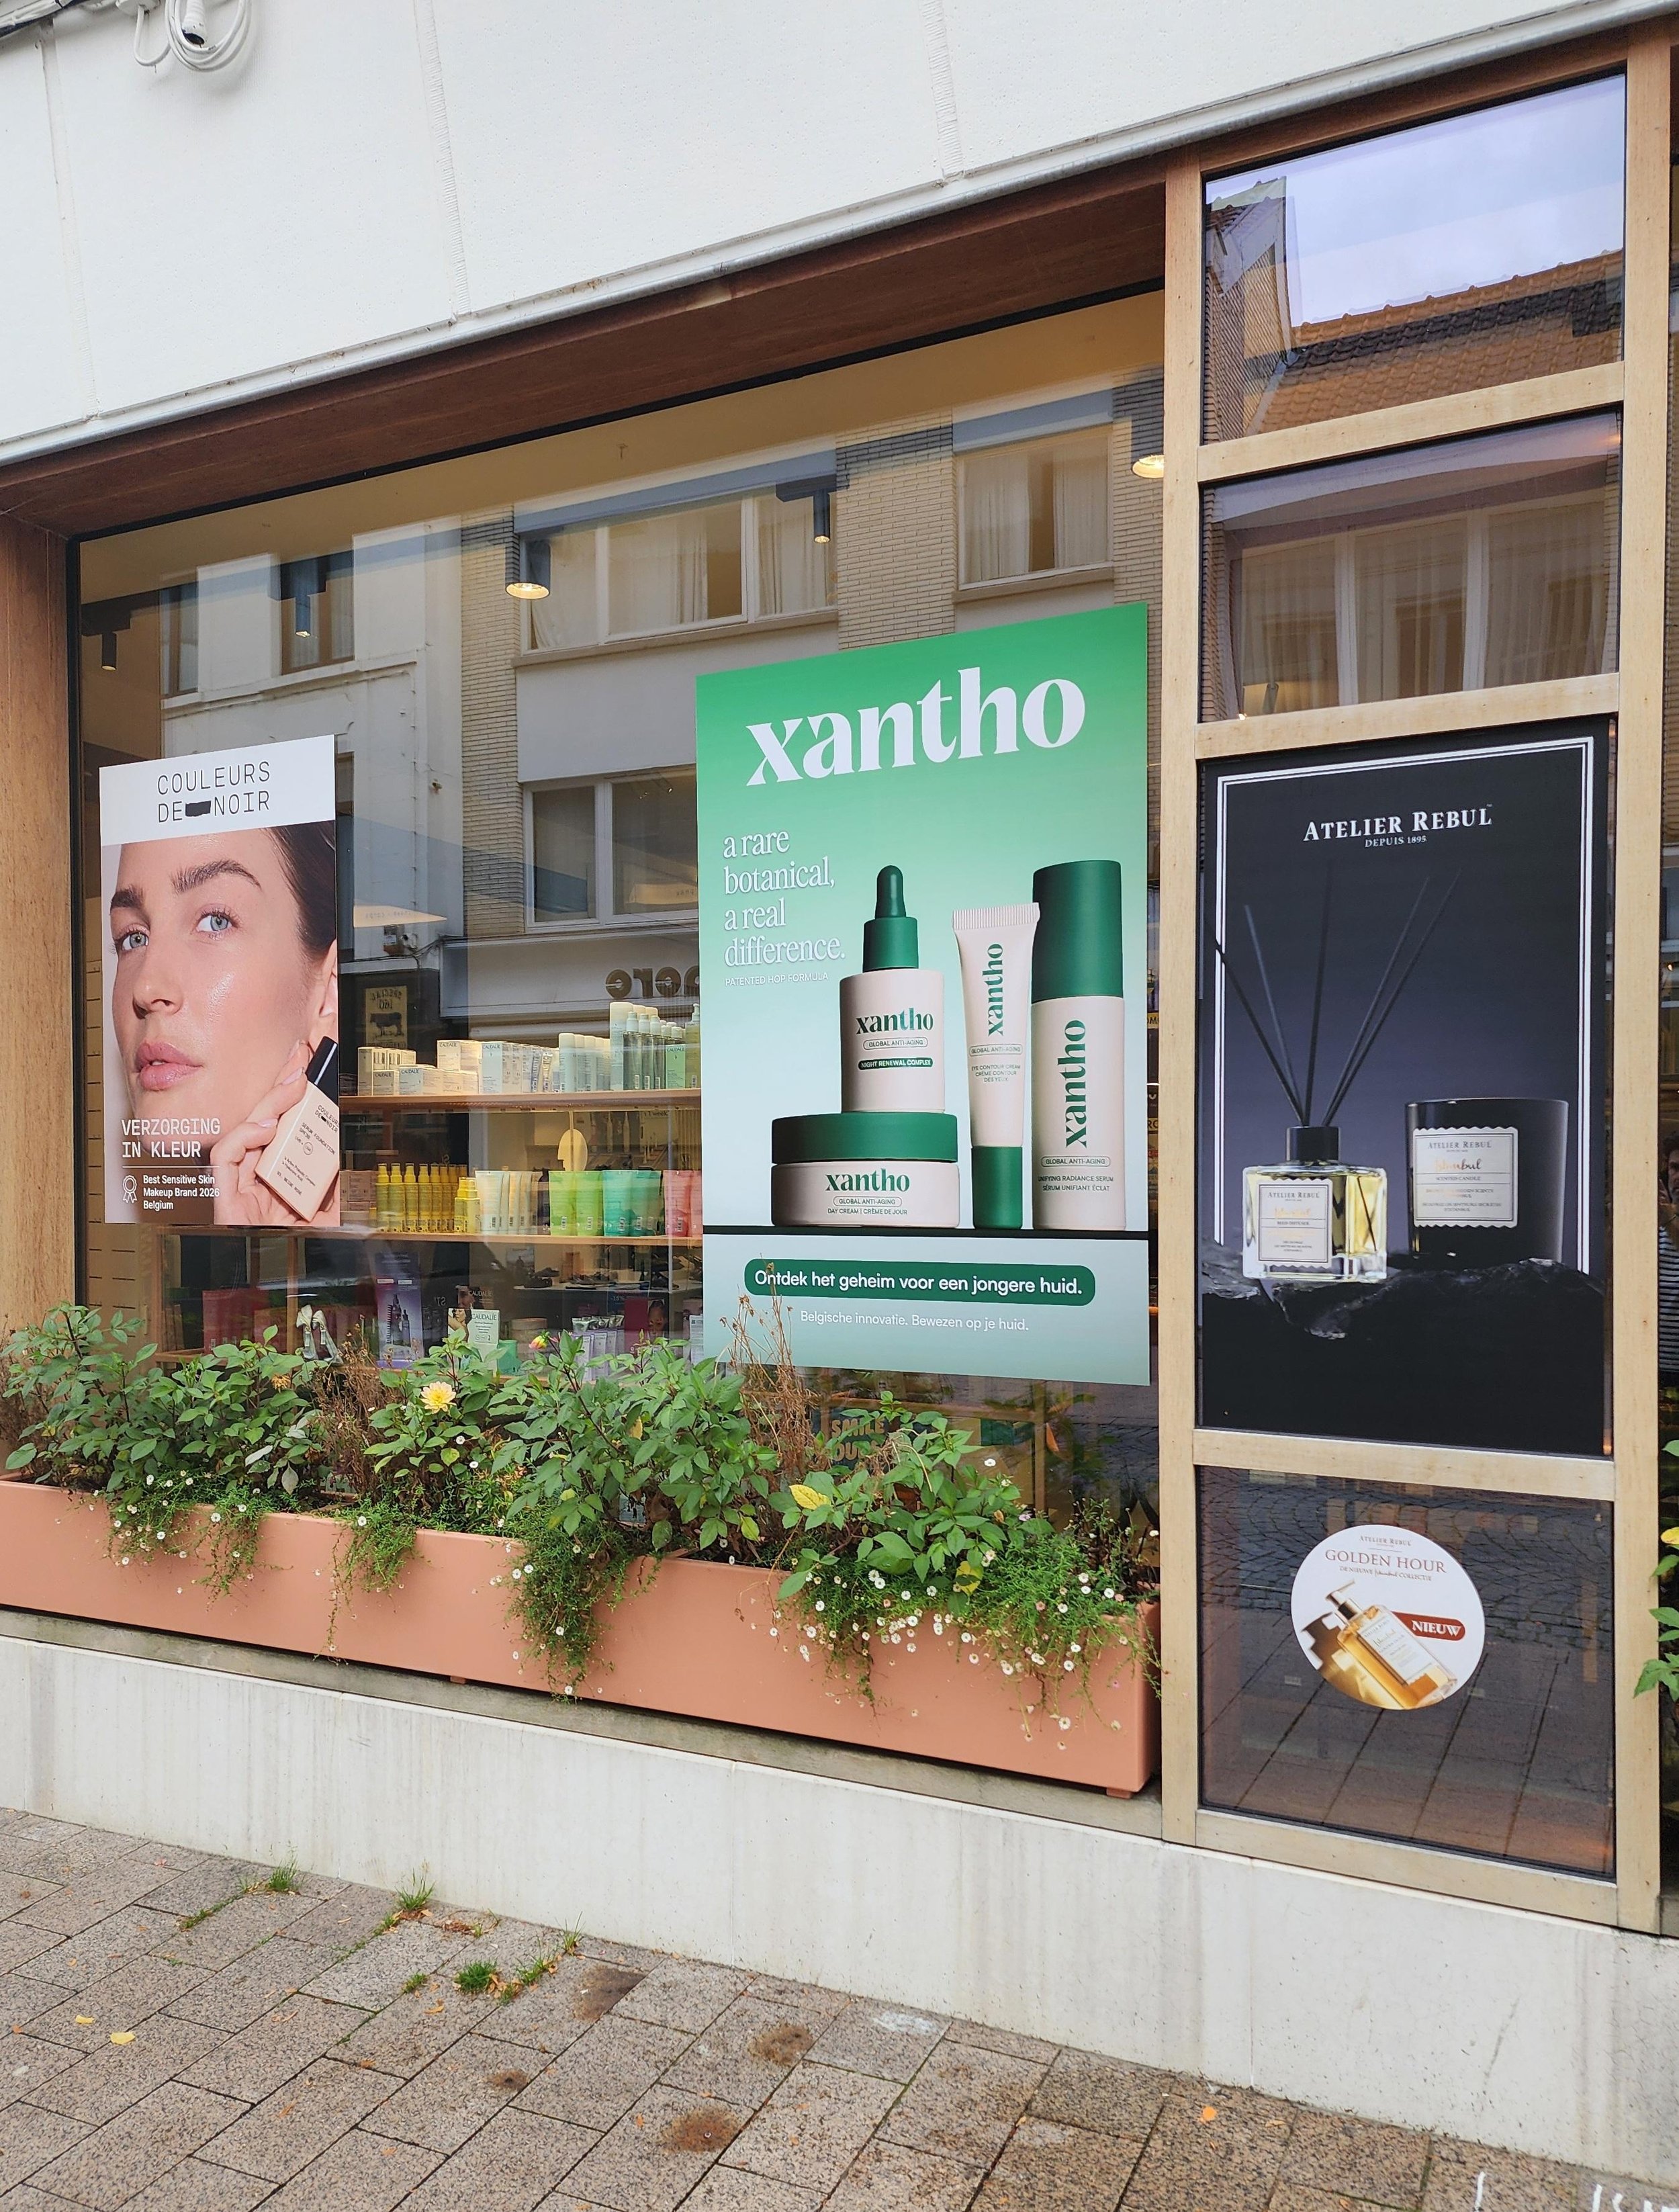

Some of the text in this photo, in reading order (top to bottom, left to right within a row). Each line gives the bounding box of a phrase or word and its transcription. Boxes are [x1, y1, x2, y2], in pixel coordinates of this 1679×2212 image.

[745, 666, 1085, 787] xantho
[158, 761, 270, 795] COULEURS
[158, 791, 269, 823] DE NOIR
[1303, 809, 1492, 841] ATELIER REBUL
[723, 831, 790, 858] a rare
[1365, 836, 1427, 848] DEPUIS 1895
[723, 856, 835, 895] botanical,
[724, 897, 786, 930] a real
[725, 935, 846, 967] difference.
[725, 972, 829, 986] PATENTED HOP FORMULA
[982, 943, 1003, 1036] xantho
[856, 1008, 934, 1034] xantho
[1057, 1020, 1087, 1149] xantho
[122, 1118, 220, 1135] VERZORGING
[122, 1141, 201, 1157] IN KLEUR
[143, 1175, 215, 1184] Best Sensitive Skin
[825, 1168, 910, 1192] xantho
[143, 1188, 220, 1198] Makeup Brand 2026
[143, 1200, 173, 1211] Belgium
[755, 1270, 1083, 1296] Ontdek het geheim voor een jongere huid.
[801, 1311, 1029, 1331] Belgische innovatie. Bewezen op je huid.
[1360, 1536, 1388, 1544] ATELIER
[1390, 1538, 1411, 1546] REBUL
[1325, 1549, 1447, 1573] GOLDEN HOUR
[1412, 1620, 1462, 1637] NIEUW
